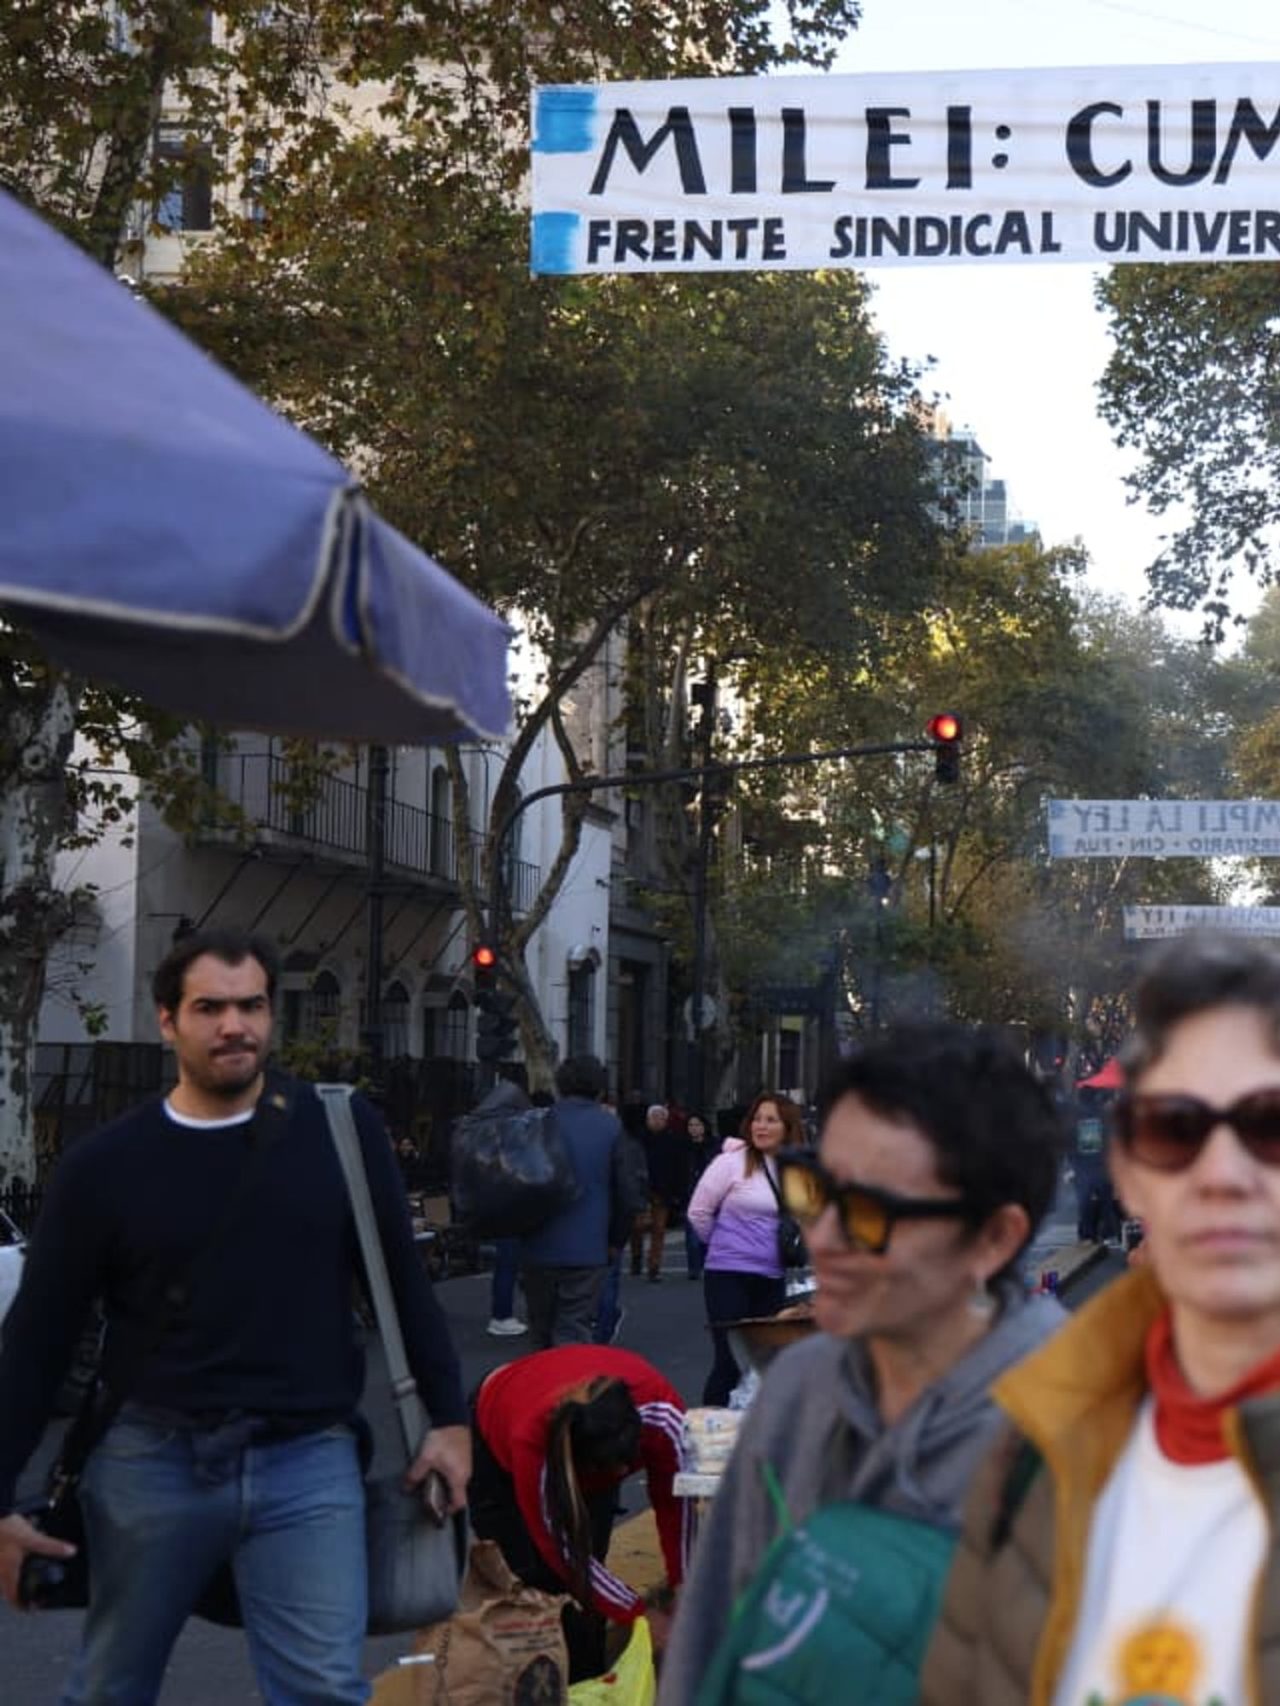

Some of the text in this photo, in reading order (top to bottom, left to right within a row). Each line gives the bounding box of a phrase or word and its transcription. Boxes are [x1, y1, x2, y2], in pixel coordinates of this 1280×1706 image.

[589, 105, 1011, 195] MILEI:
[586, 218, 787, 264] FRENTE
[829, 210, 1061, 258] SINDICAL
